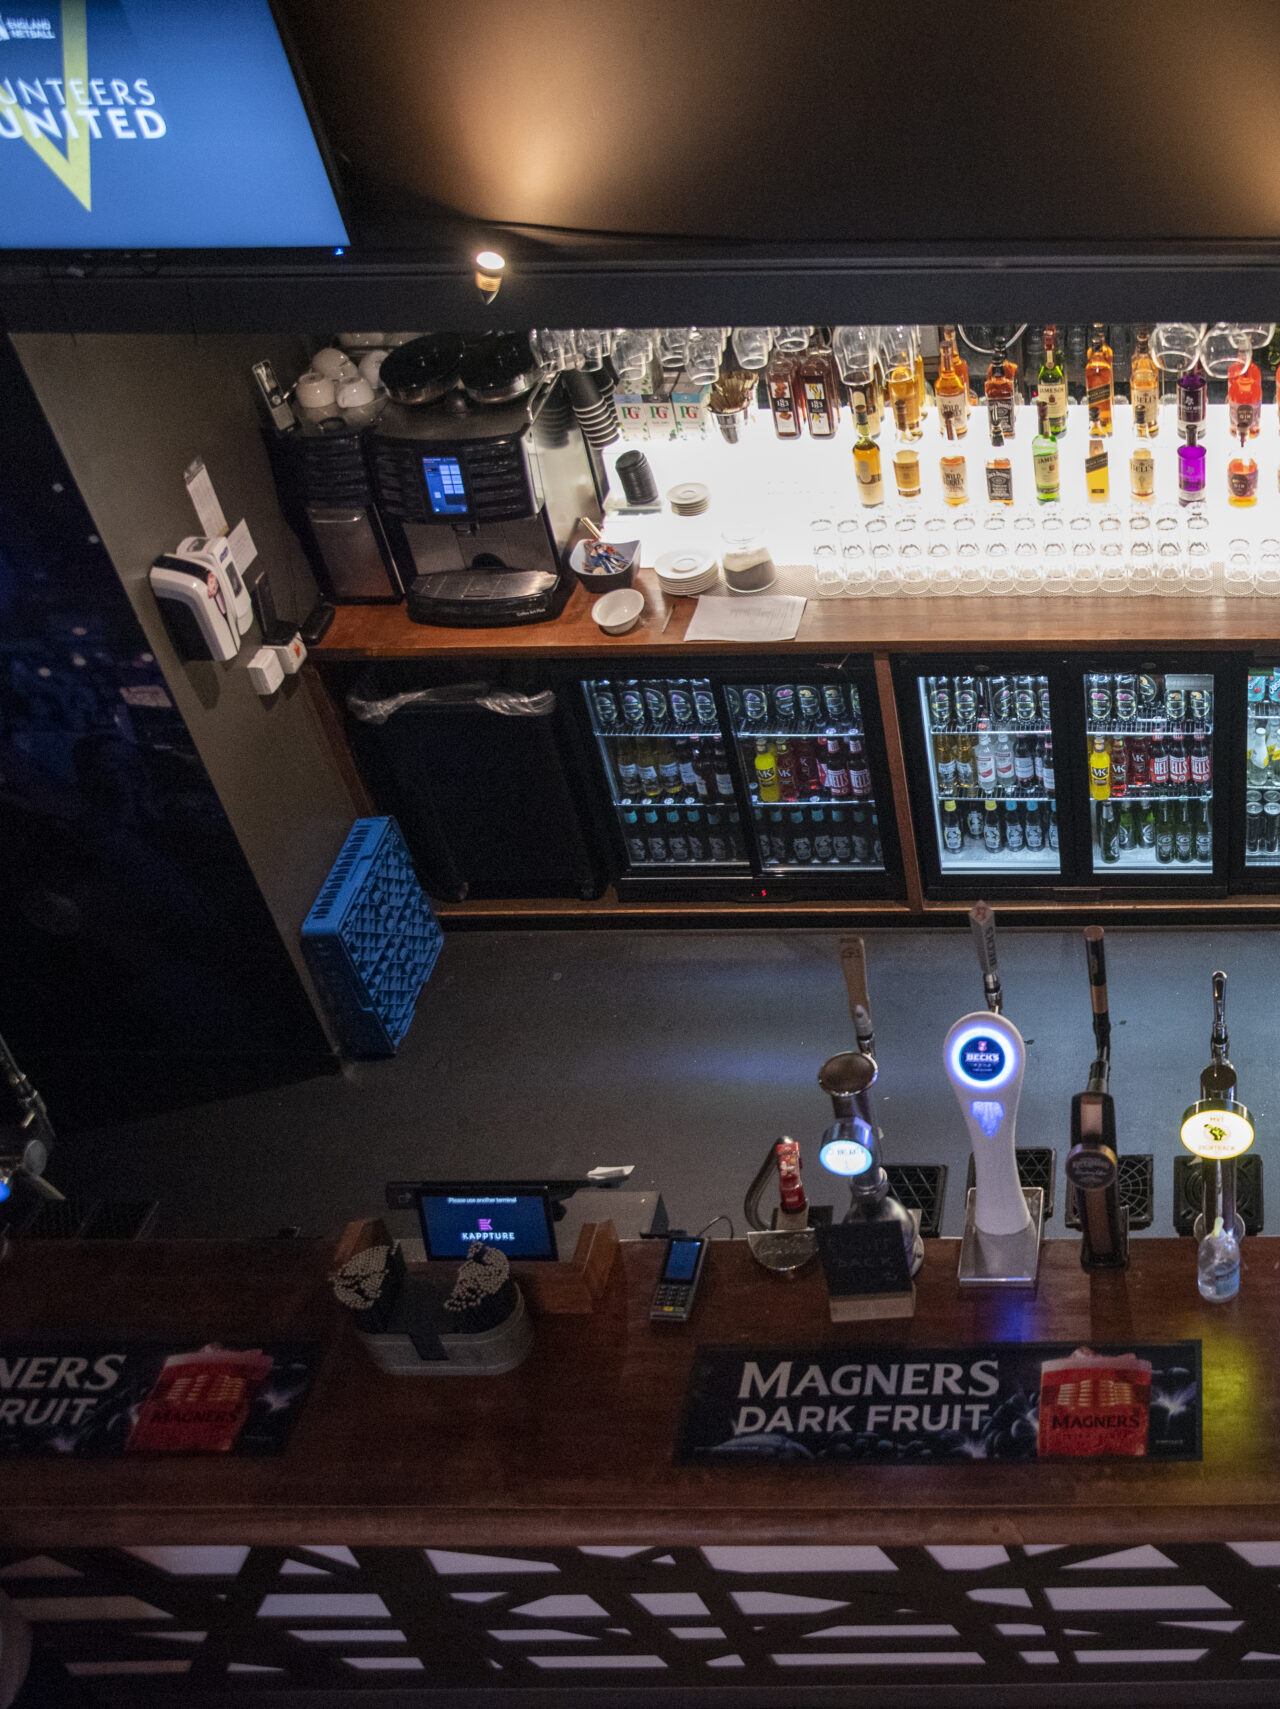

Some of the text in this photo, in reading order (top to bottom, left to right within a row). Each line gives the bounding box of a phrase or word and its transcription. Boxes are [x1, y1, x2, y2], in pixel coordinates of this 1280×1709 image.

[621, 406, 640, 419] PG
[649, 406, 668, 419] PG
[680, 406, 698, 419] PG
[1132, 753, 1145, 763] VK
[778, 768, 791, 778] VK
[1092, 767, 1108, 777] VK
[1112, 764, 1126, 774] VK
[758, 770, 773, 779] VK
[966, 1053, 999, 1062] BECK'S
[461, 1231, 516, 1241] KAPPTURE
[737, 1359, 1000, 1398] MAGNERS
[737, 1403, 990, 1434] DARK FRUIT
[1051, 1412, 1140, 1430] MAGNERS
